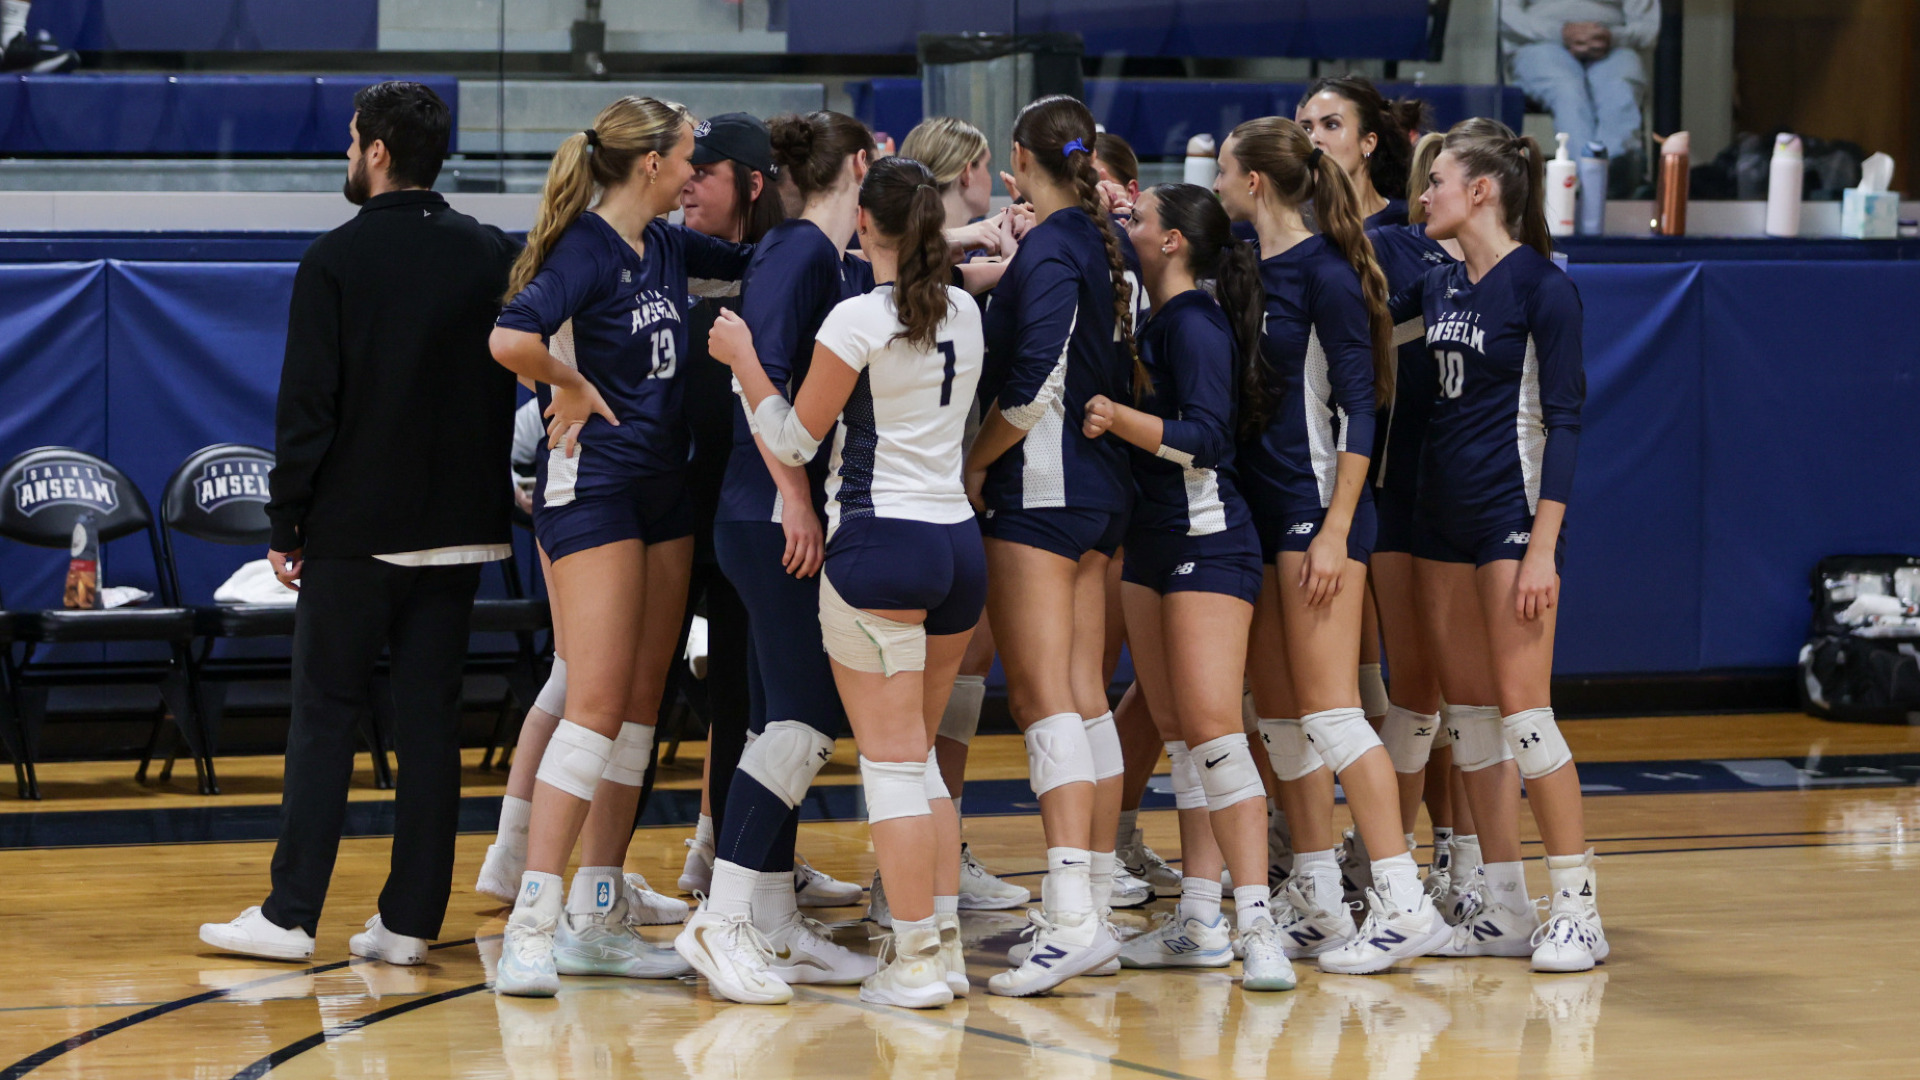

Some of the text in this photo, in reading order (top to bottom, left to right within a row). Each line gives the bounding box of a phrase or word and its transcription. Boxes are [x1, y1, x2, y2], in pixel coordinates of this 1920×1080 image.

[647, 328, 677, 380] 13
[936, 339, 957, 407] 1
[1434, 349, 1465, 399] 10
[30, 466, 94, 481] SAINT
[21, 478, 114, 508] ANSELM
[201, 475, 271, 505] ANSEL
[1163, 935, 1200, 954] N
[1288, 926, 1325, 947] N
[1369, 929, 1407, 951] N
[1030, 944, 1068, 969] N
